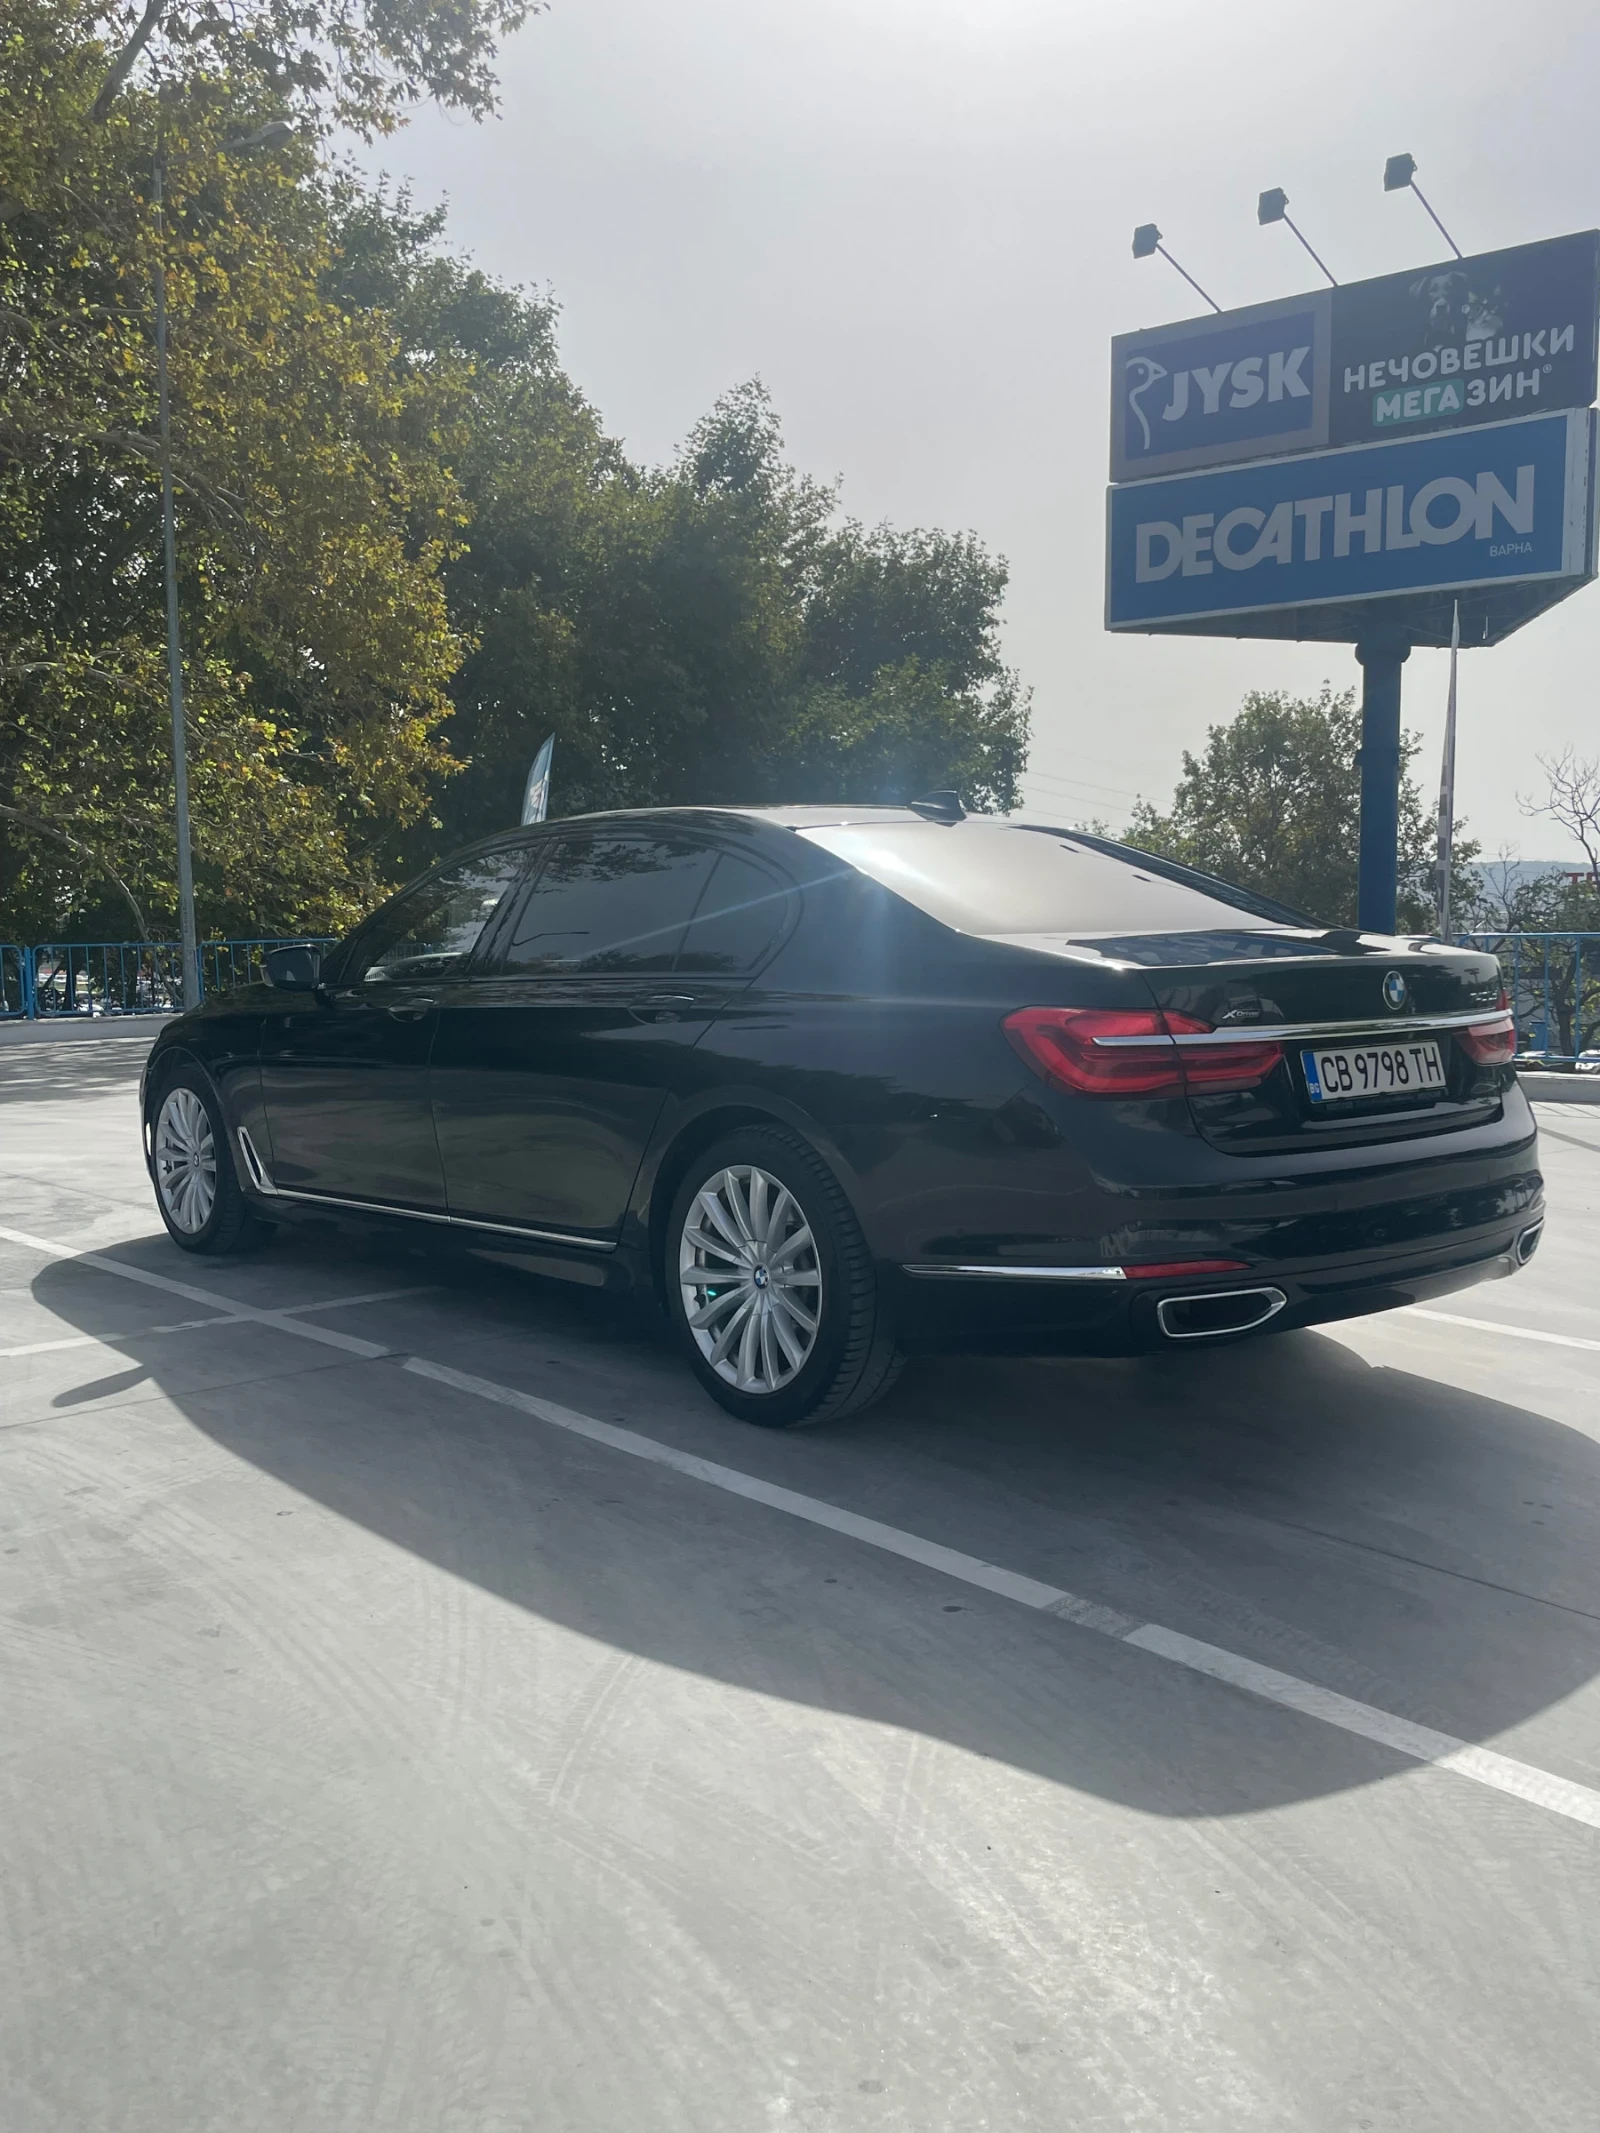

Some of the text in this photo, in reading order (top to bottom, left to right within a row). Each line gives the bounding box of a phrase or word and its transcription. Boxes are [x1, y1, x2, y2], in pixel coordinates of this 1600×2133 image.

[1162, 346, 1311, 421] JYSK
[1344, 325, 1574, 393] НЕЧОВЕШКИ
[1135, 464, 1535, 583] DECATHLON
[1489, 540, 1533, 557] ВАРНА
